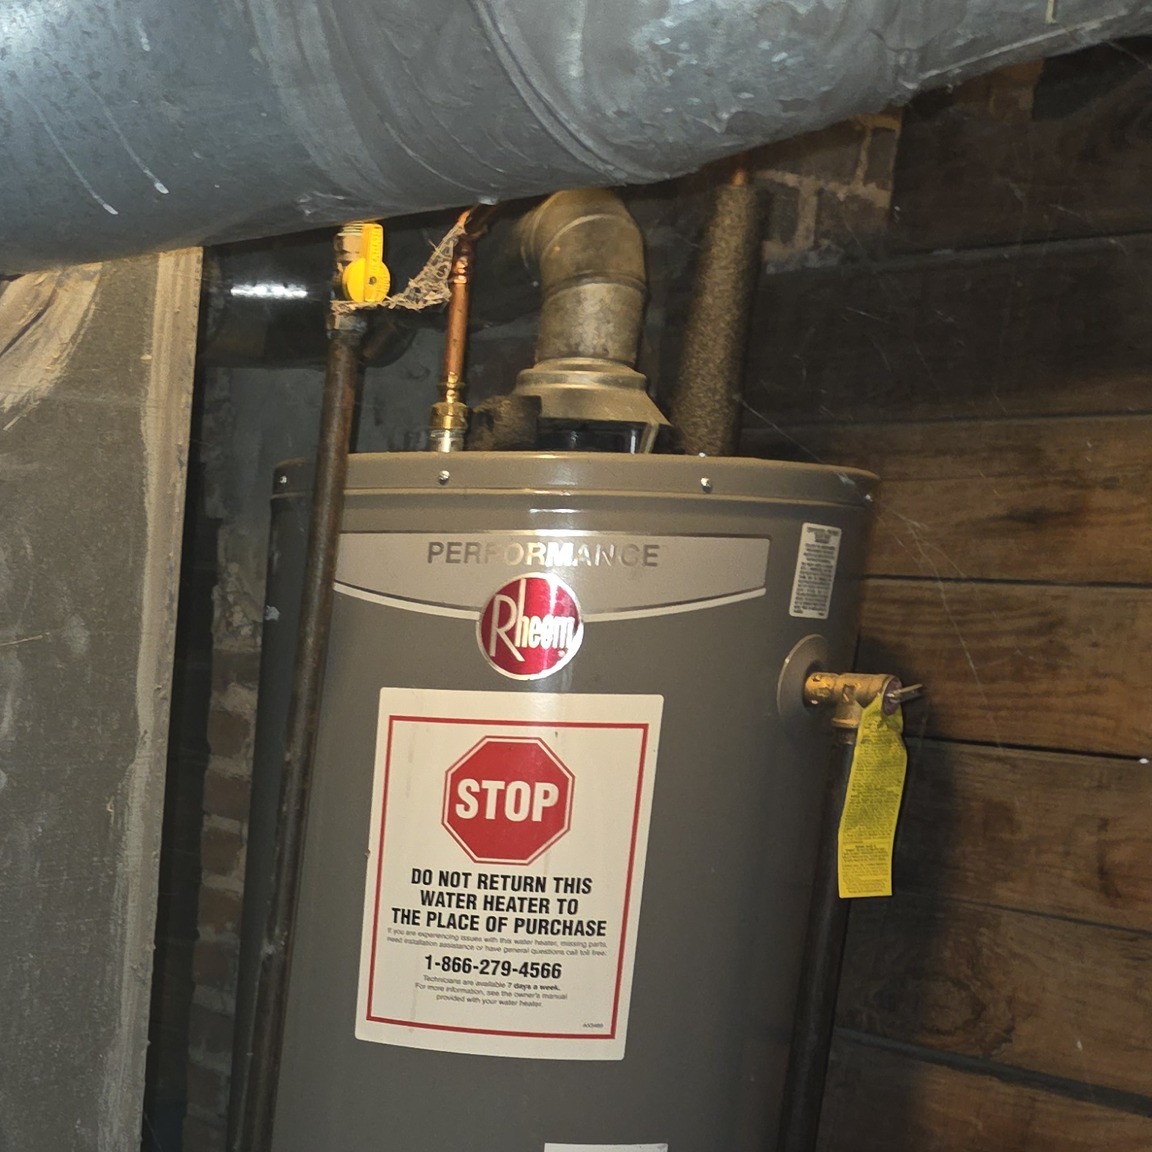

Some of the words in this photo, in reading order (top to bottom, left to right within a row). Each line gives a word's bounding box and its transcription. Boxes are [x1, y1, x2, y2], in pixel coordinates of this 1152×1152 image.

[427, 541, 660, 568] PERFORMANCE
[455, 778, 559, 822] STOP
[411, 868, 433, 885] DO
[438, 870, 472, 888] NOT
[477, 873, 546, 893] RETURN
[553, 877, 593, 894] THIS
[420, 890, 477, 910] WATER
[483, 895, 550, 914] HEATER
[557, 899, 578, 915] TO
[392, 908, 421, 926] THE
[426, 911, 479, 930] PLACE
[486, 916, 508, 932] OF
[514, 918, 607, 936] PURCHASE
[424, 954, 562, 979] 1-866-279-4566
